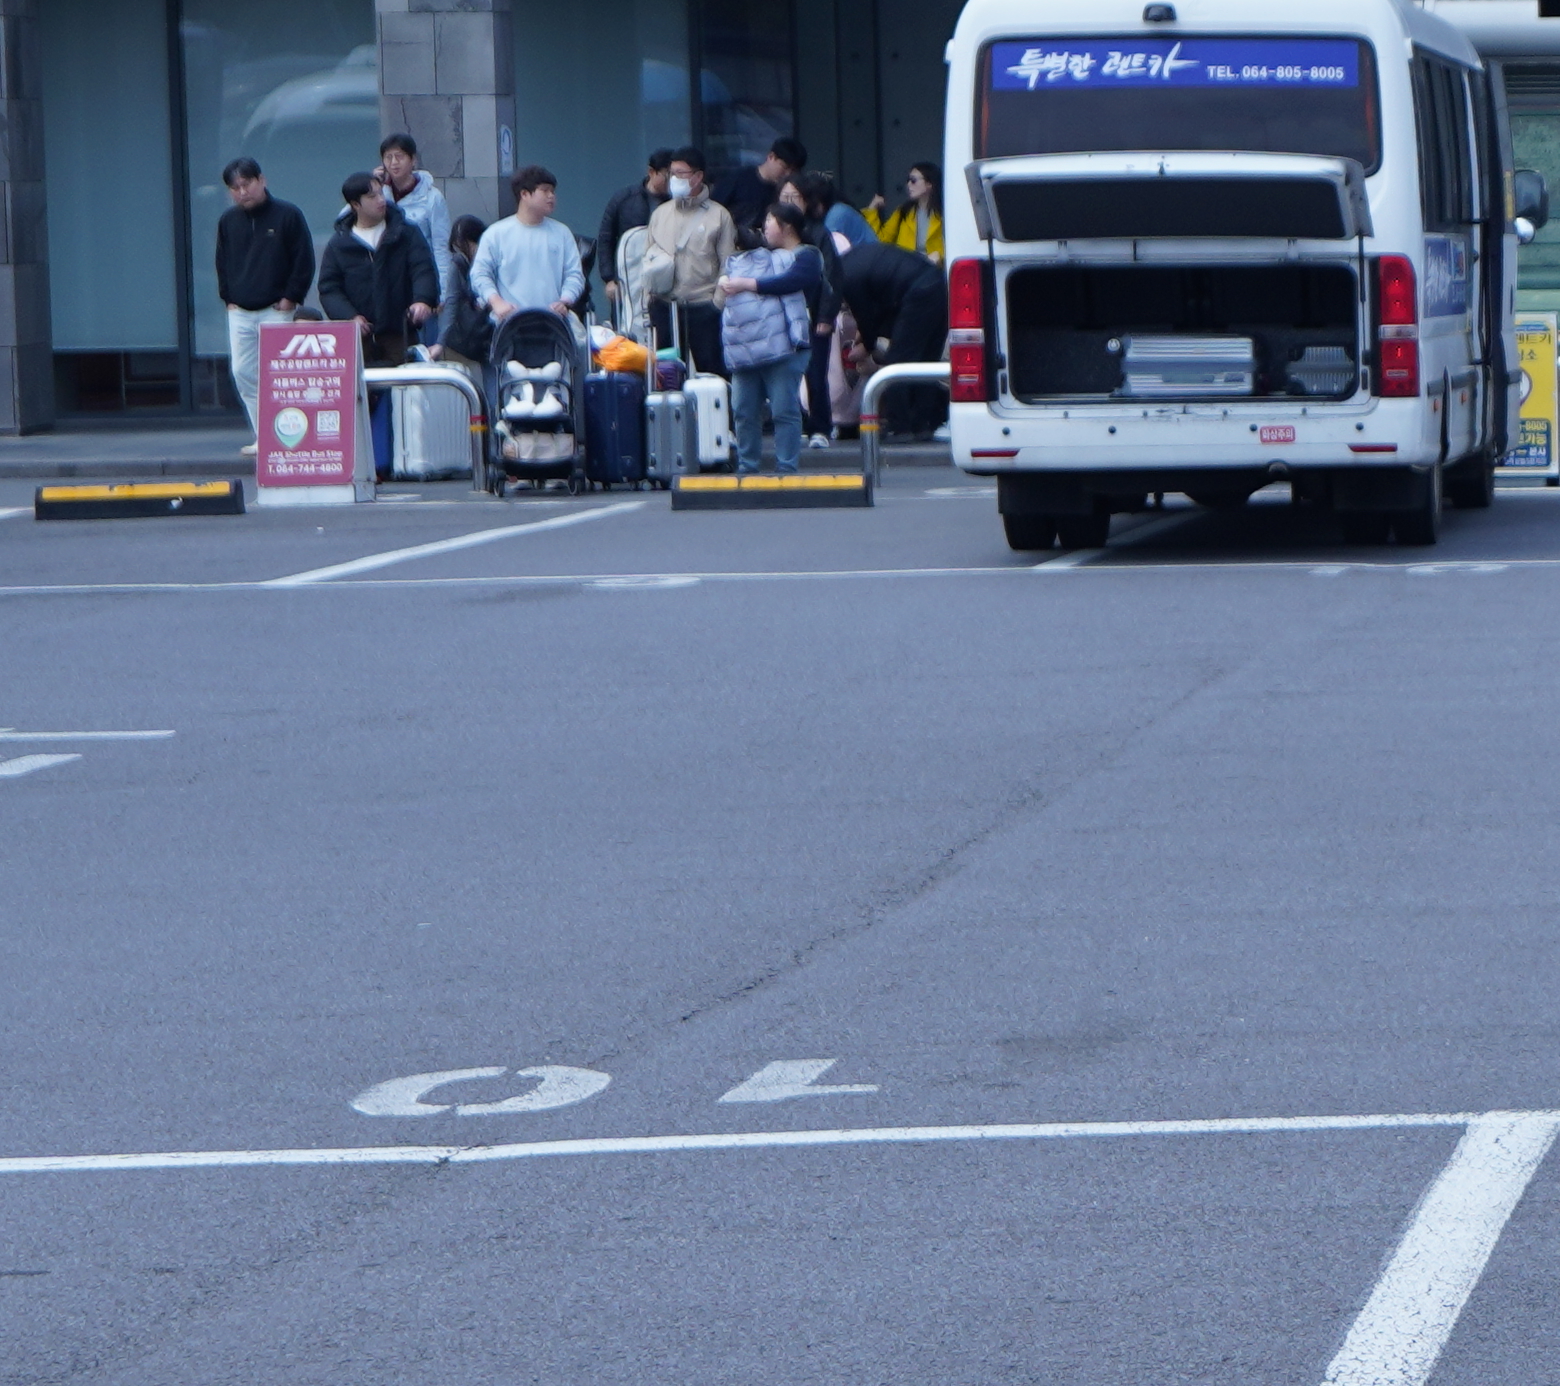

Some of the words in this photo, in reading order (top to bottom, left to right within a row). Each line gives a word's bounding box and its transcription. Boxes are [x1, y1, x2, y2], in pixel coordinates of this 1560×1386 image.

[1006, 47, 1097, 90] 특별한
[1101, 41, 1200, 79] 렌트카
[280, 334, 337, 357] JAR
